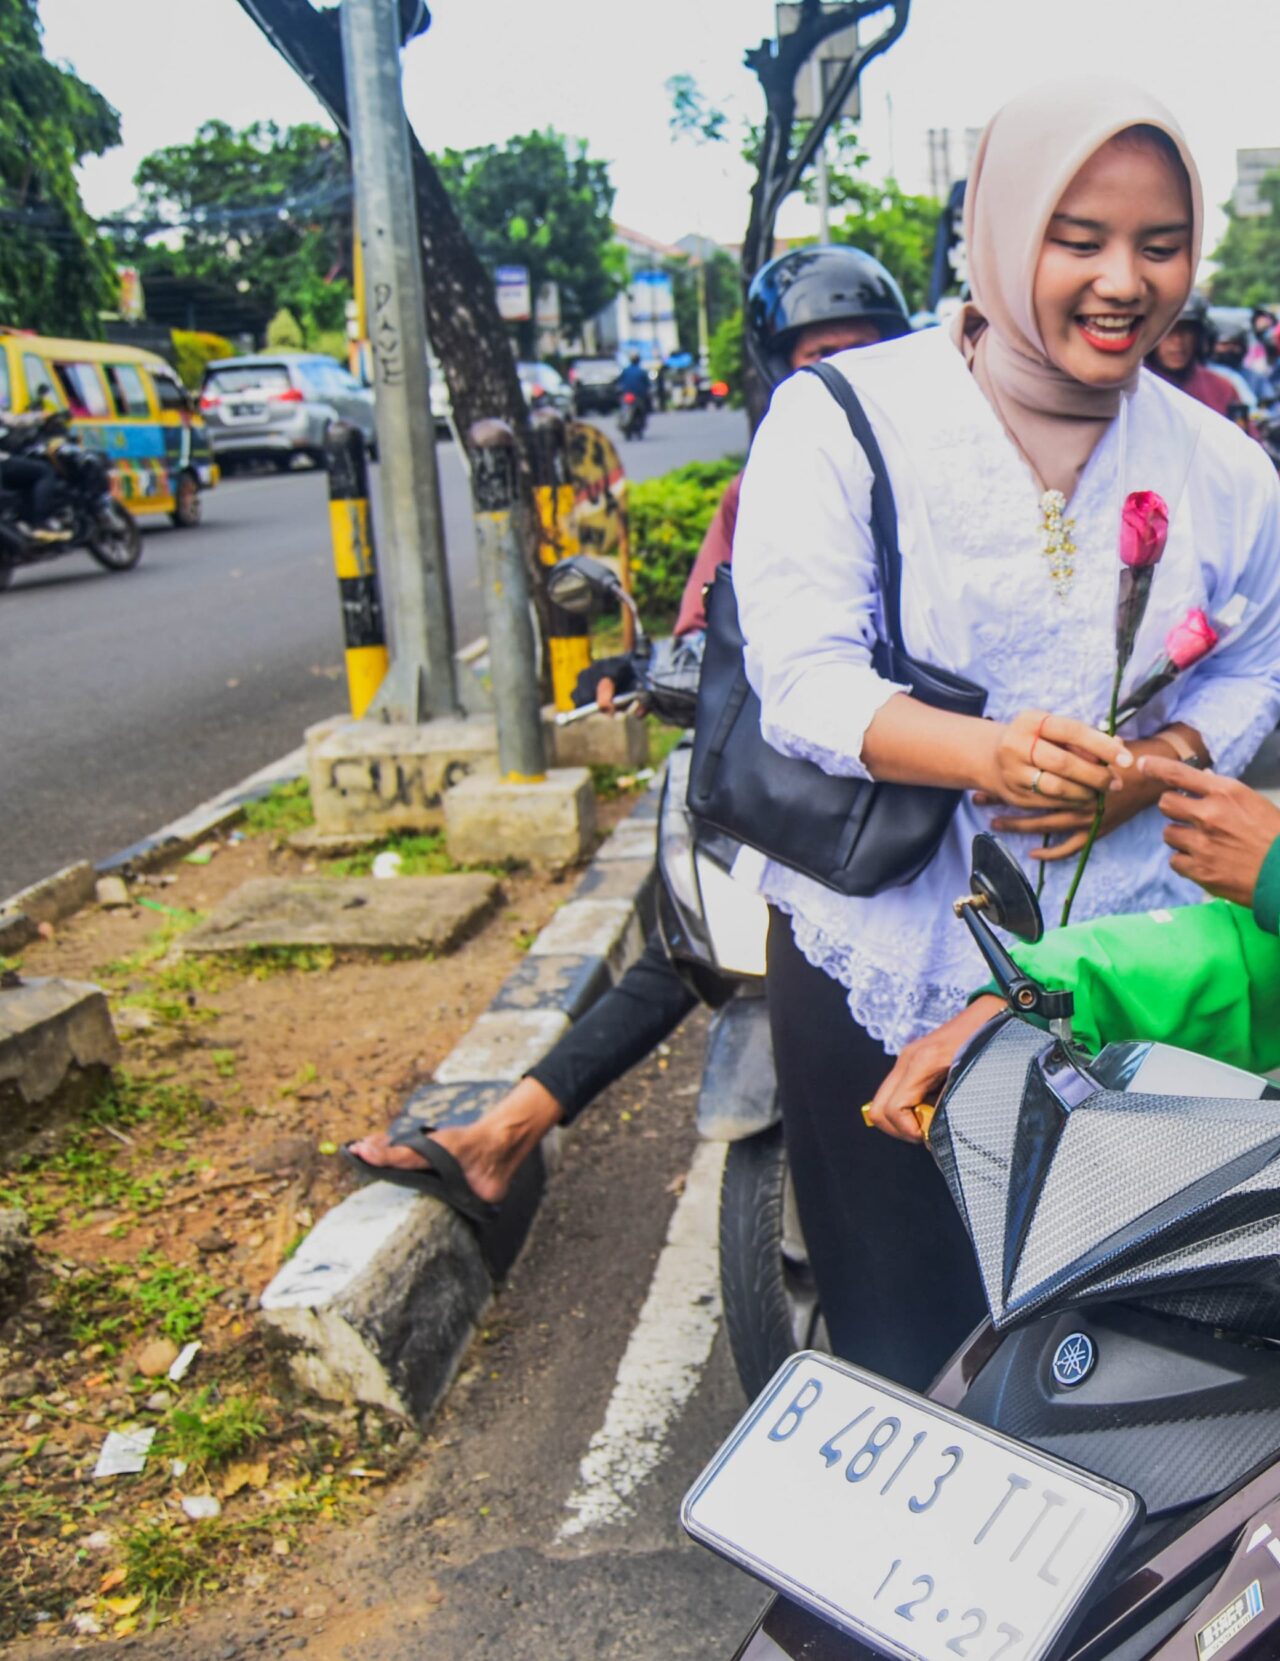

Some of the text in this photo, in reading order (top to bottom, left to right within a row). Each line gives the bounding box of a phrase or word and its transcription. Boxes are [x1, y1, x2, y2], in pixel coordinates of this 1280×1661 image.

[767, 1377, 1087, 1587] B 4813 TTL
